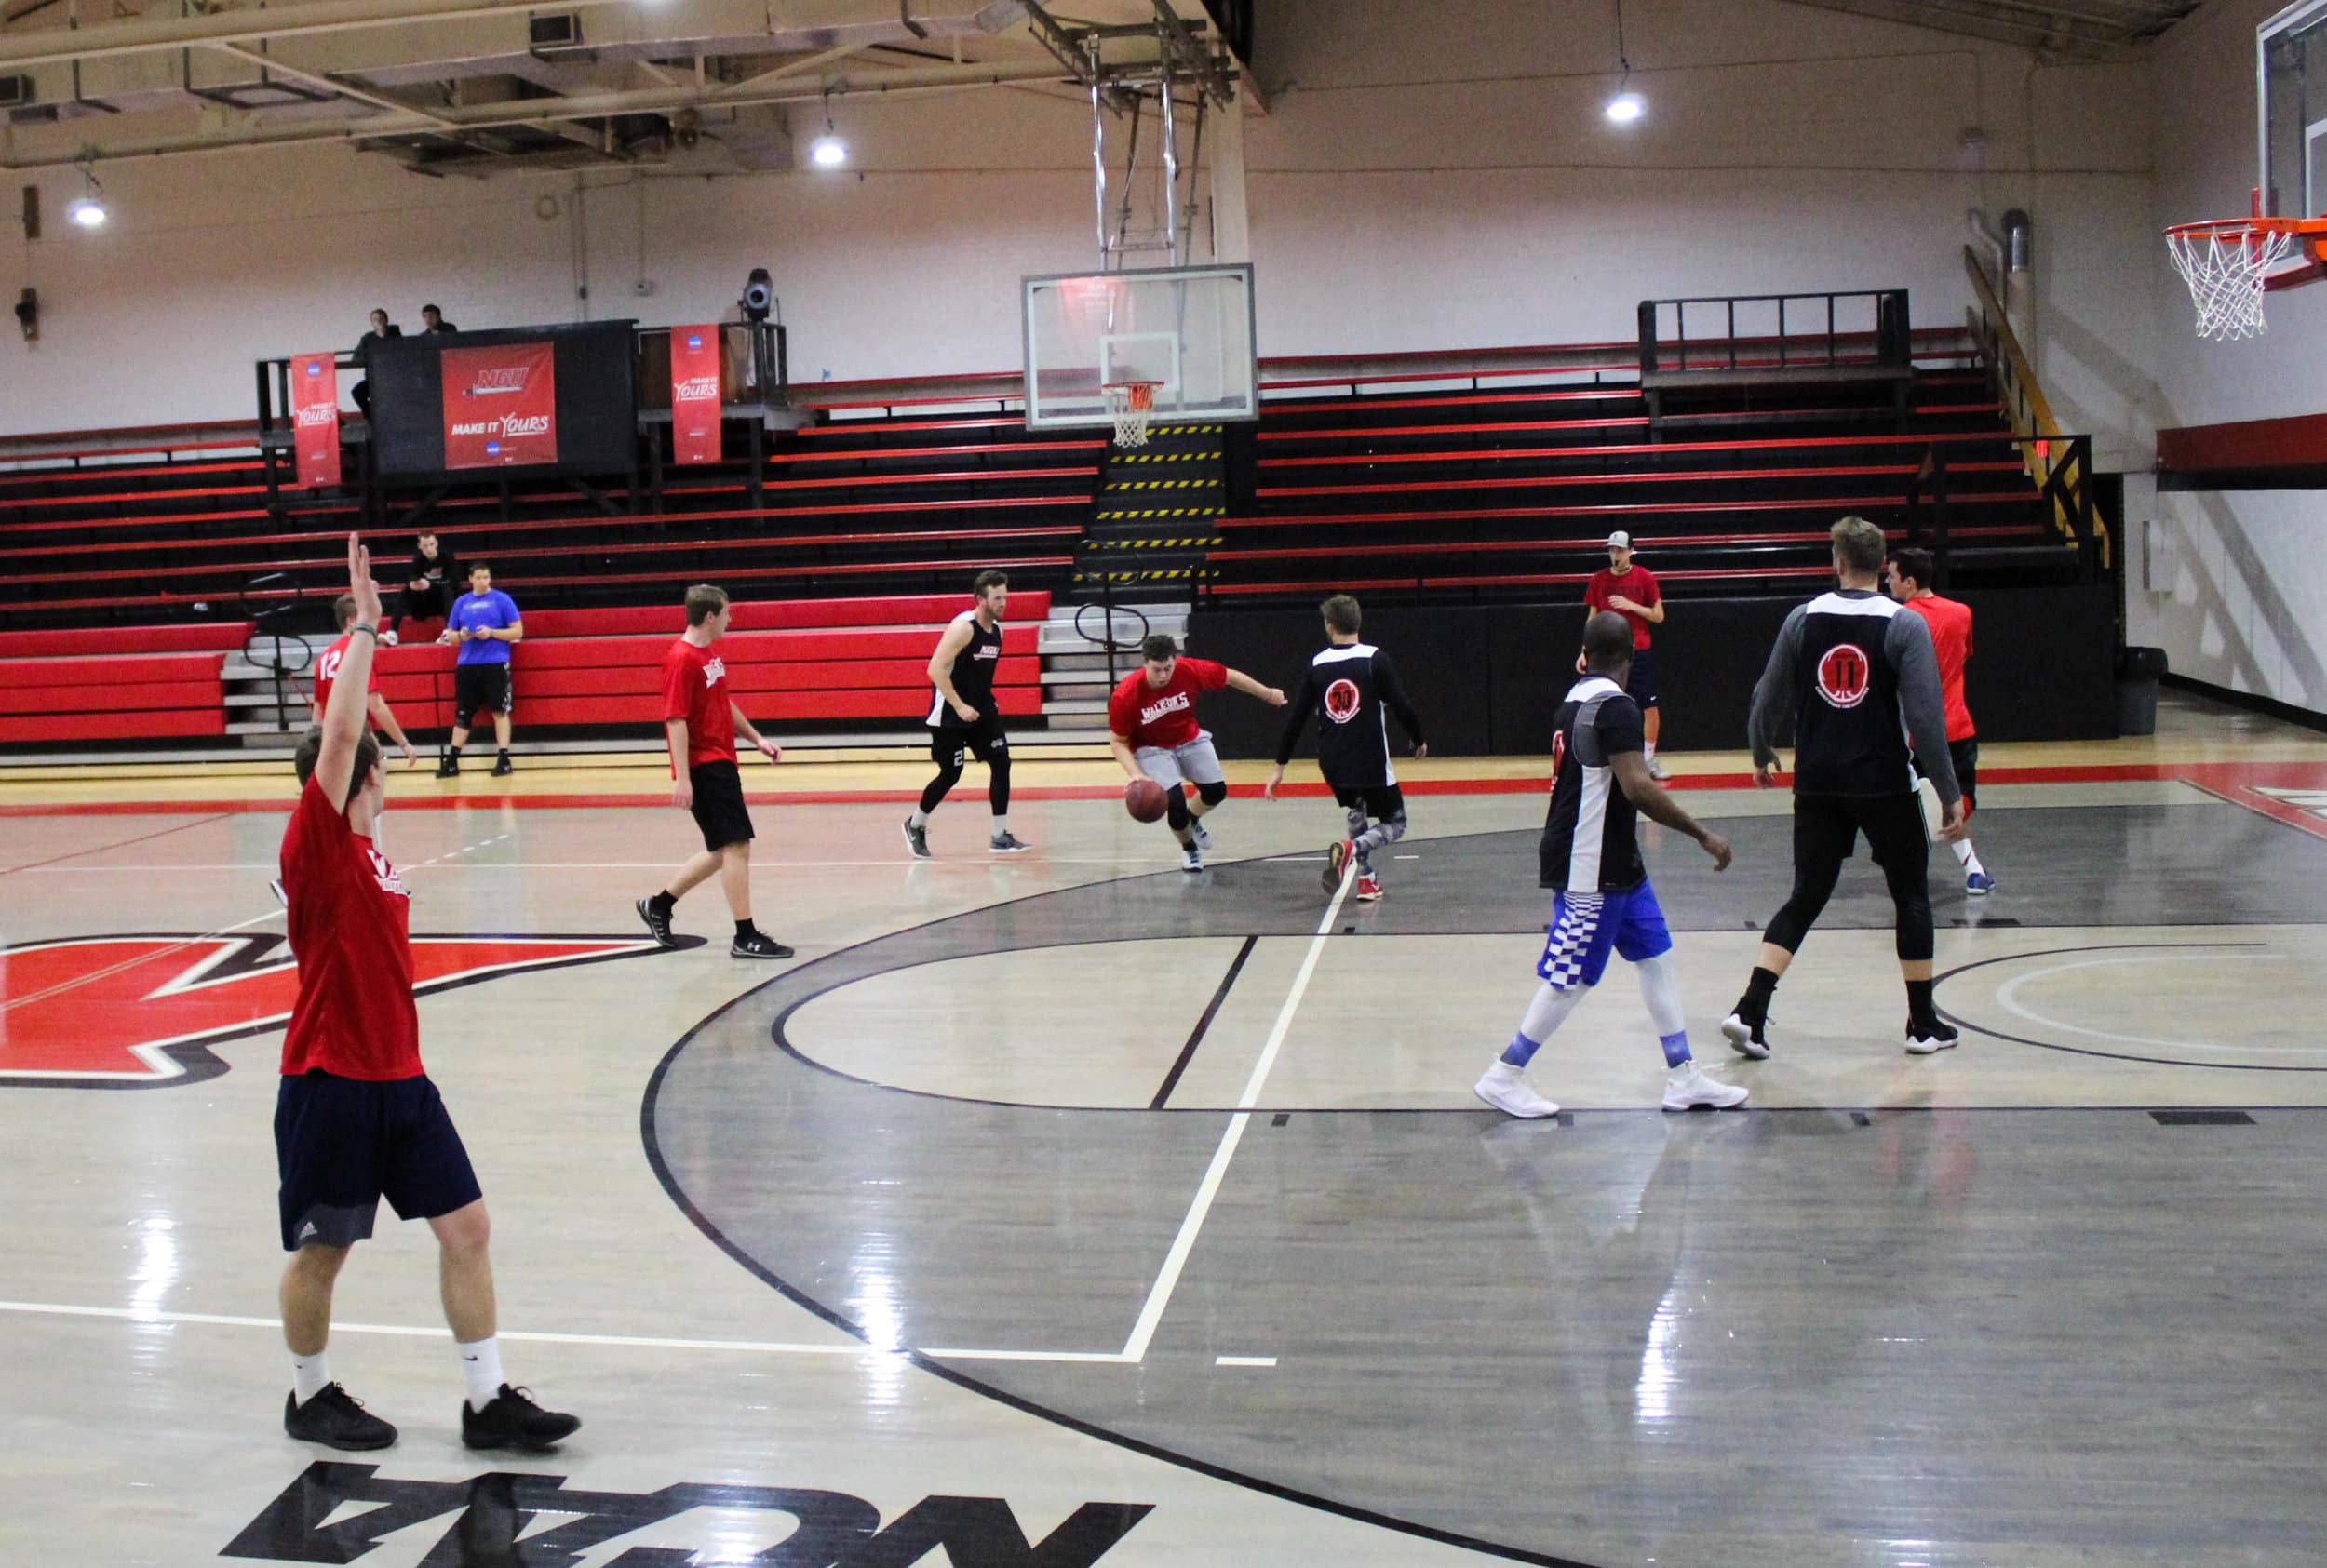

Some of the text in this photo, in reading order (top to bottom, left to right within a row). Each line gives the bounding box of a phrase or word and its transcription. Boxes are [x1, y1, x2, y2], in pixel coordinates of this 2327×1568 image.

[674, 380, 717, 402] YOURS
[451, 411, 549, 438] MAKE IT YOURS
[320, 650, 342, 680] 12
[1836, 660, 1855, 688] 11
[1332, 690, 1352, 711] 30
